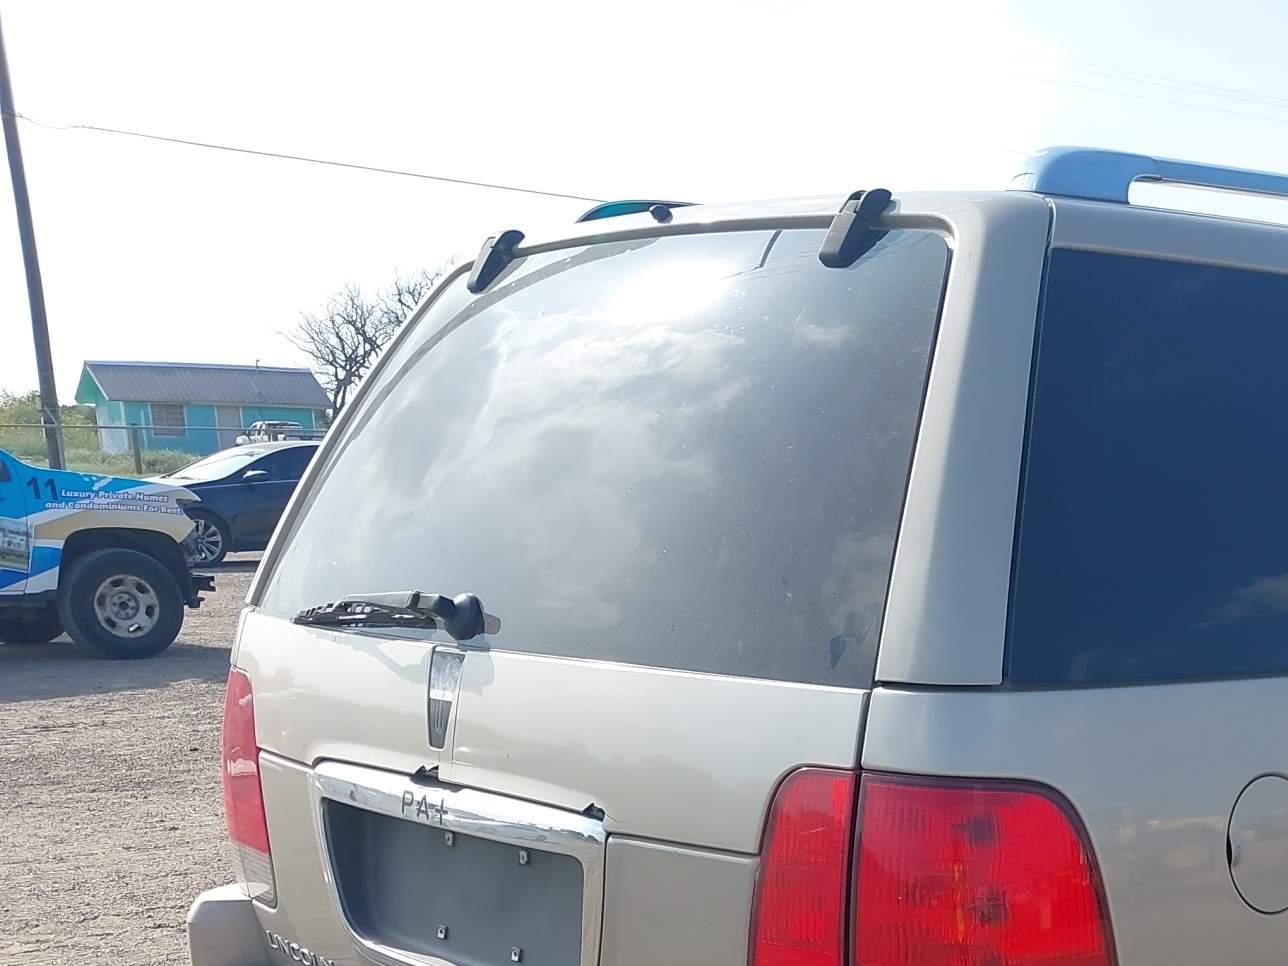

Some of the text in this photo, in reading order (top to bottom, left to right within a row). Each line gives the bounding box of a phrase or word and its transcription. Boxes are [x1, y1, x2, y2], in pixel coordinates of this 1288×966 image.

[61, 489, 169, 502] Luxury Private Homes
[45, 501, 66, 509] and
[68, 502, 141, 511] Condominiums
[143, 504, 159, 513] For
